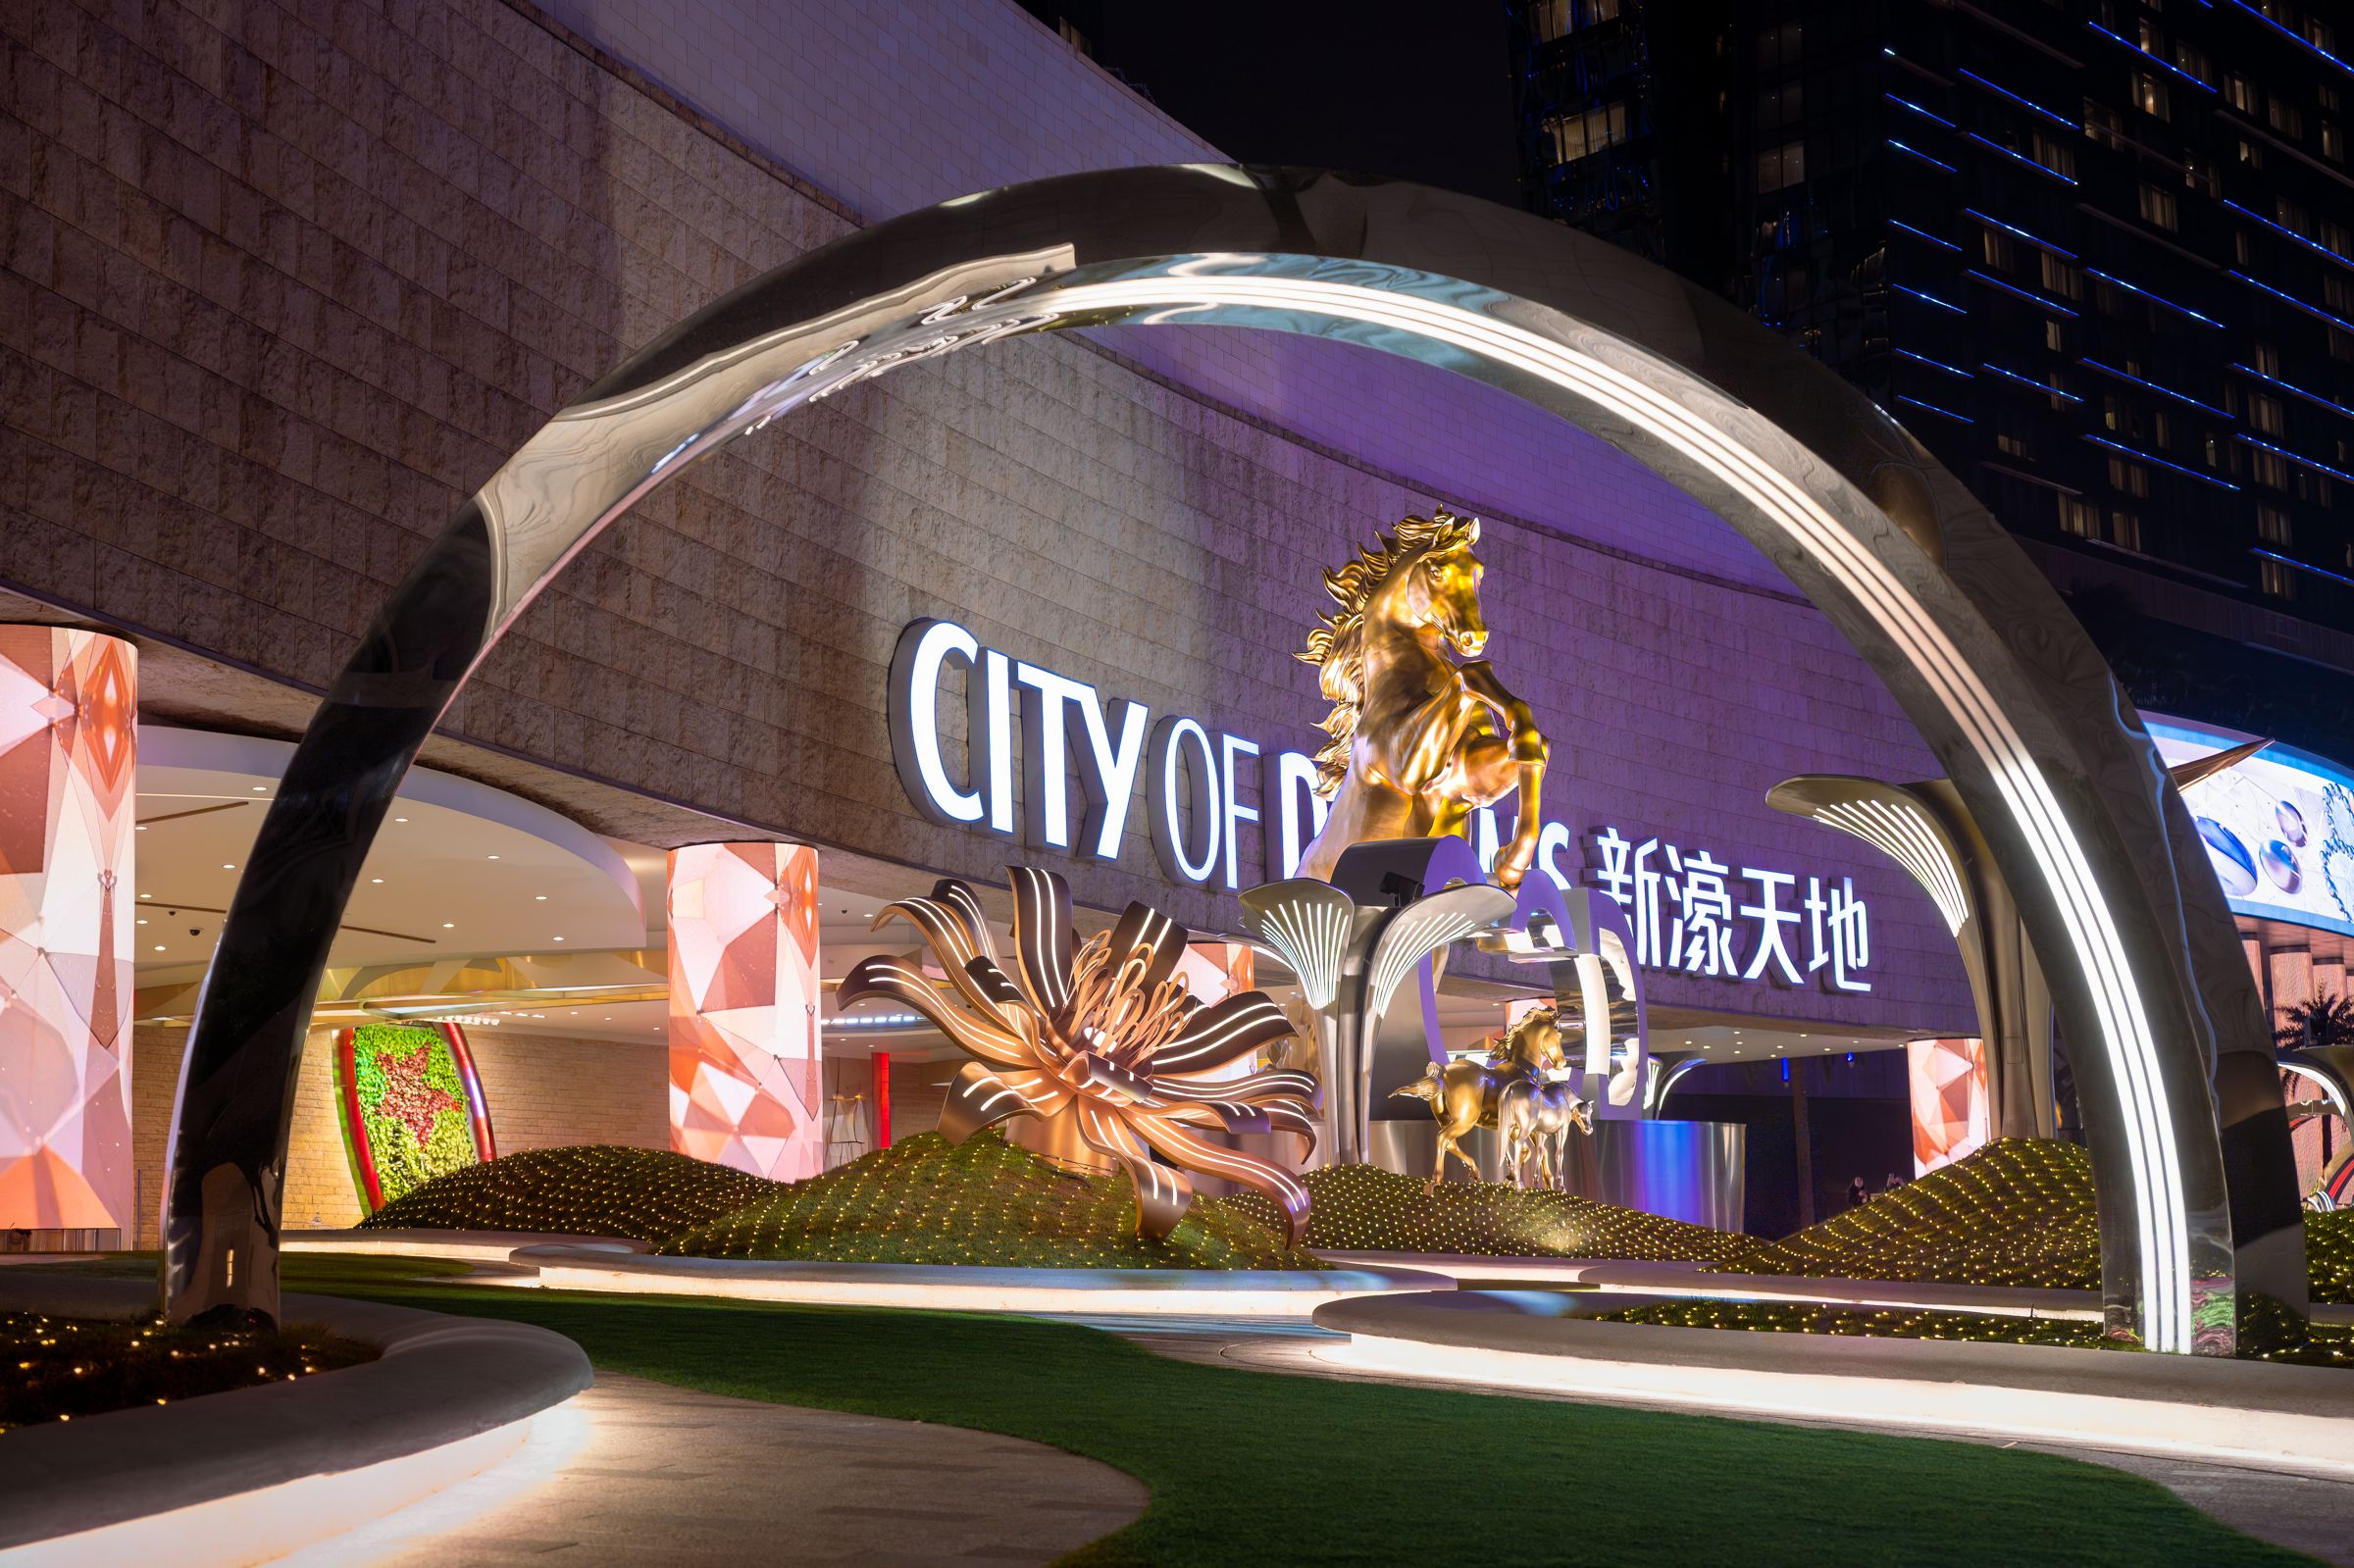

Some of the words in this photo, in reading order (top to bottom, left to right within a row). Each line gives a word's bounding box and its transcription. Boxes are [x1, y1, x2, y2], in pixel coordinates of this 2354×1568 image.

[910, 621, 1150, 861] CITY
[1164, 718, 1260, 890] OF
[1596, 827, 1872, 992] 新濠天地
